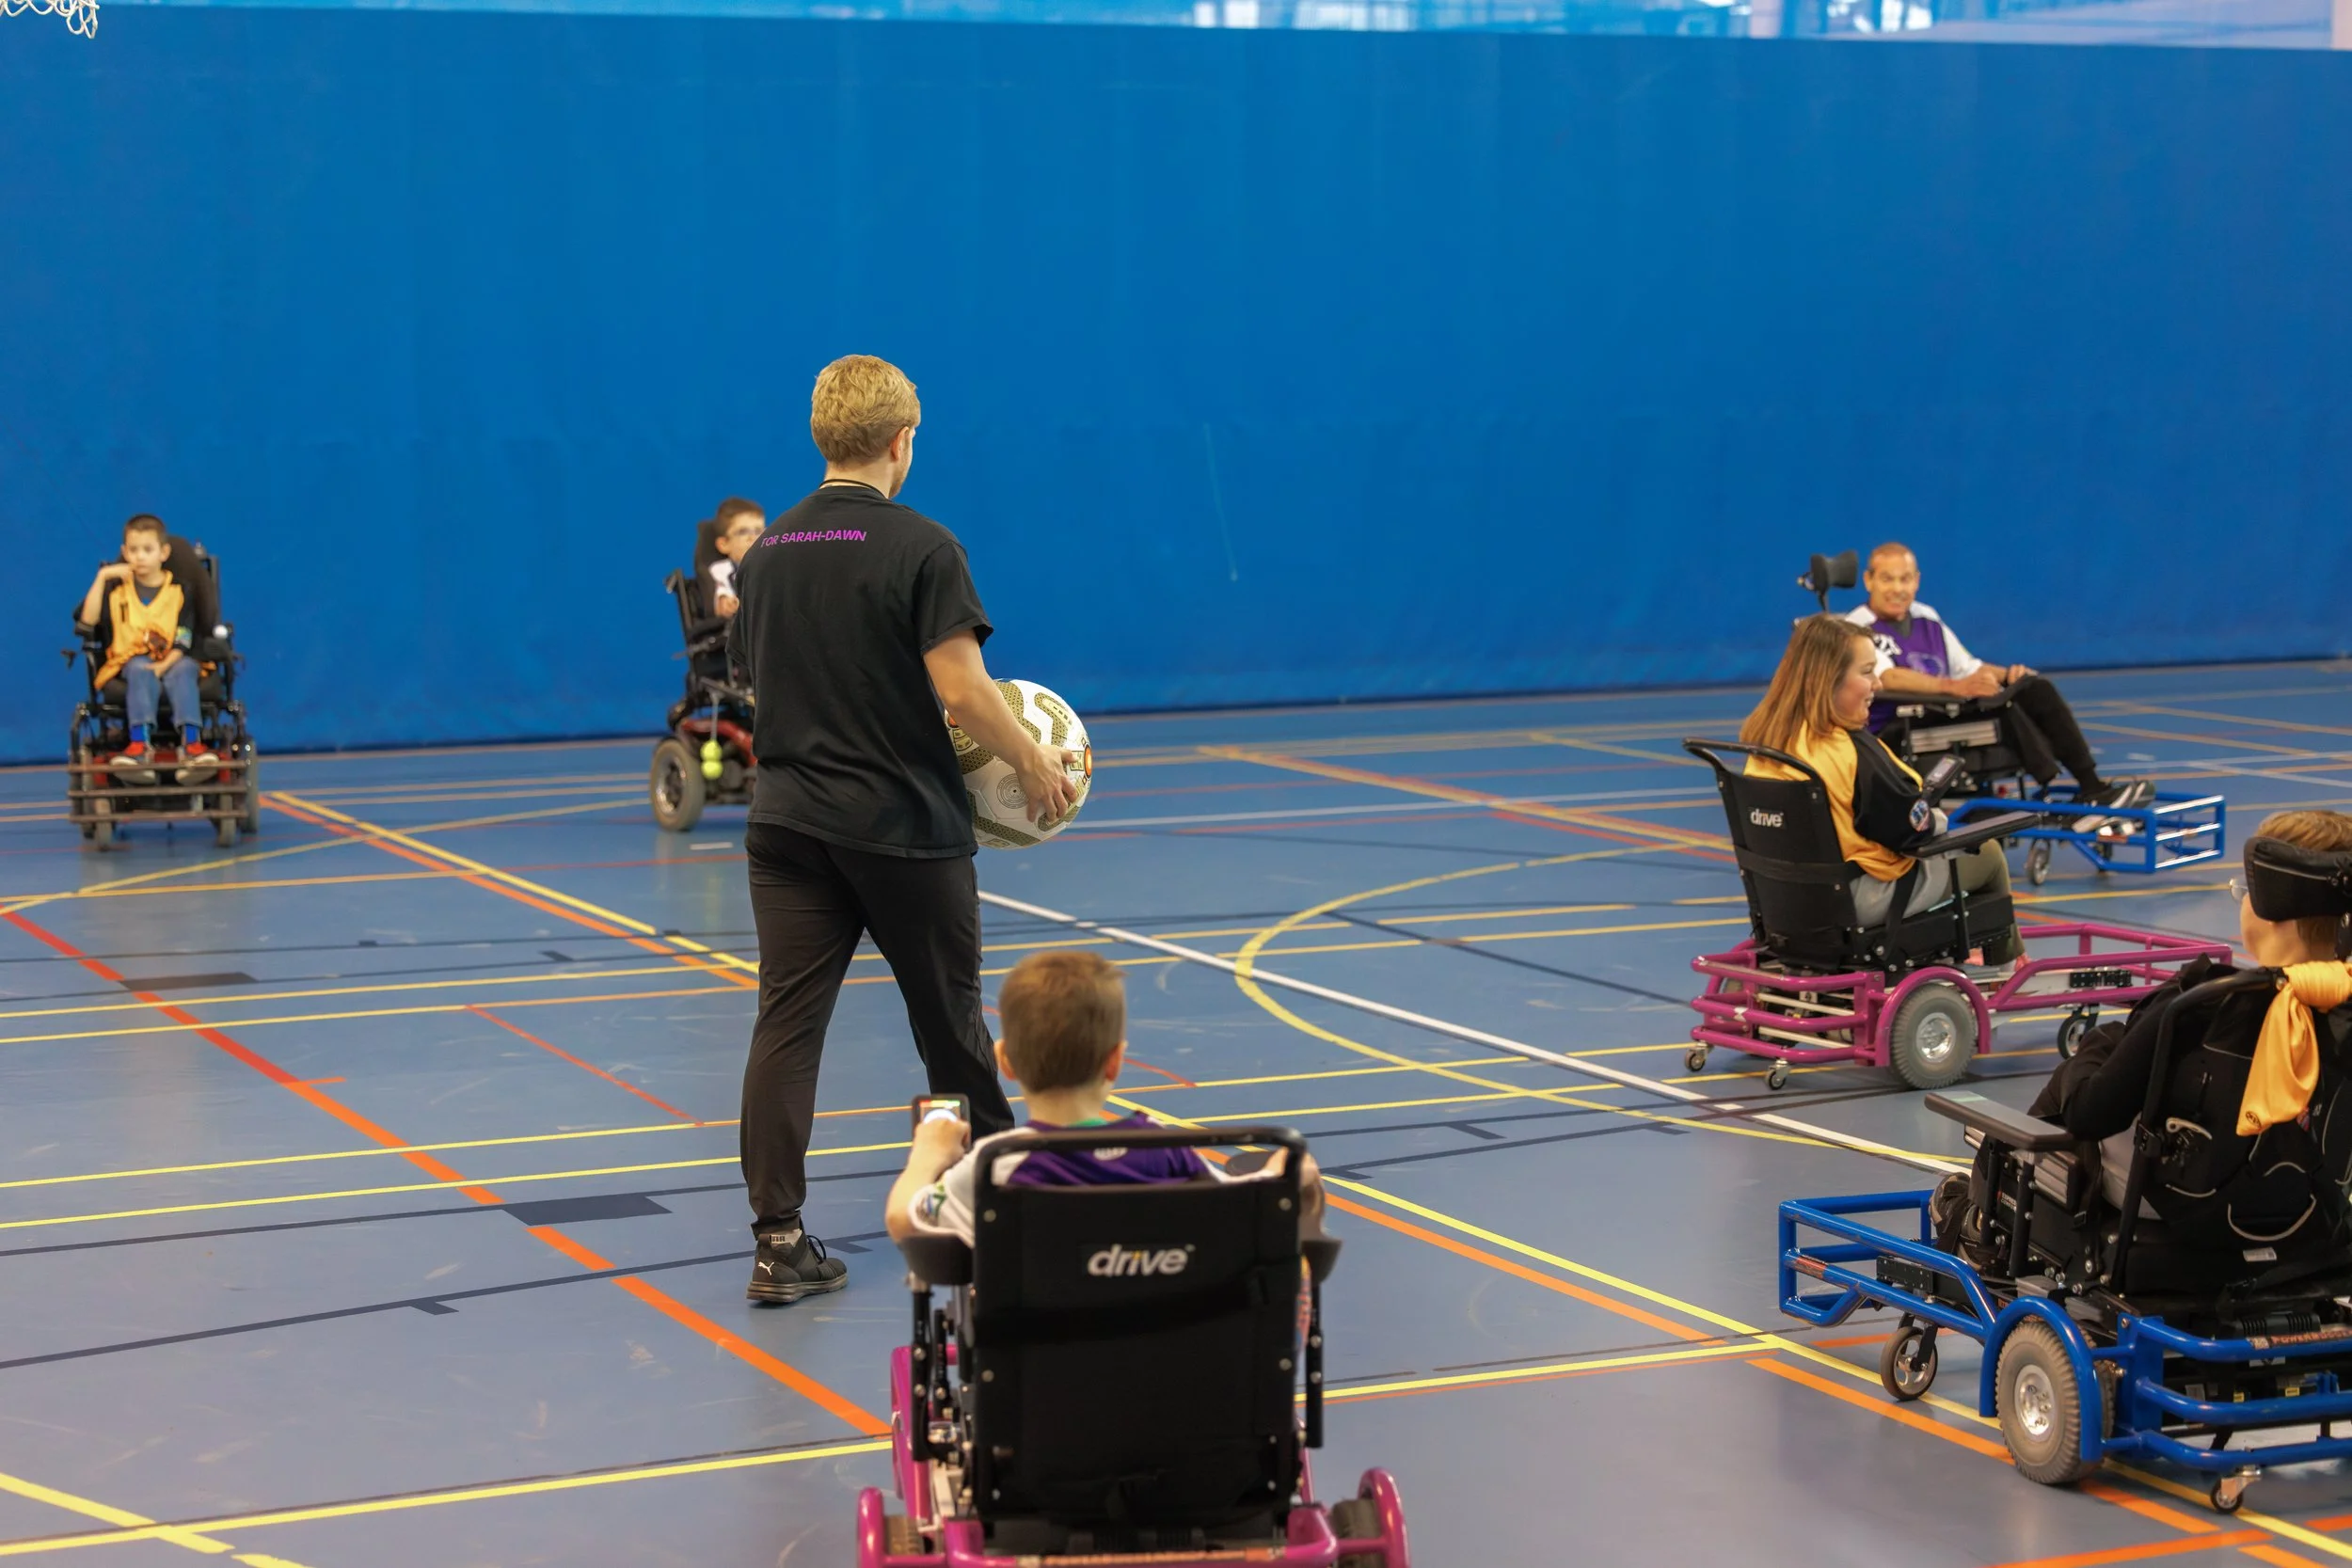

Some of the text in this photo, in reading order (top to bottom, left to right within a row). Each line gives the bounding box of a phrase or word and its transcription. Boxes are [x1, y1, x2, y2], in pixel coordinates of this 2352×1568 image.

[781, 530, 866, 544] SARAH-DAWN
[1751, 808, 1783, 828] drive
[1088, 1243, 1188, 1277] drive
